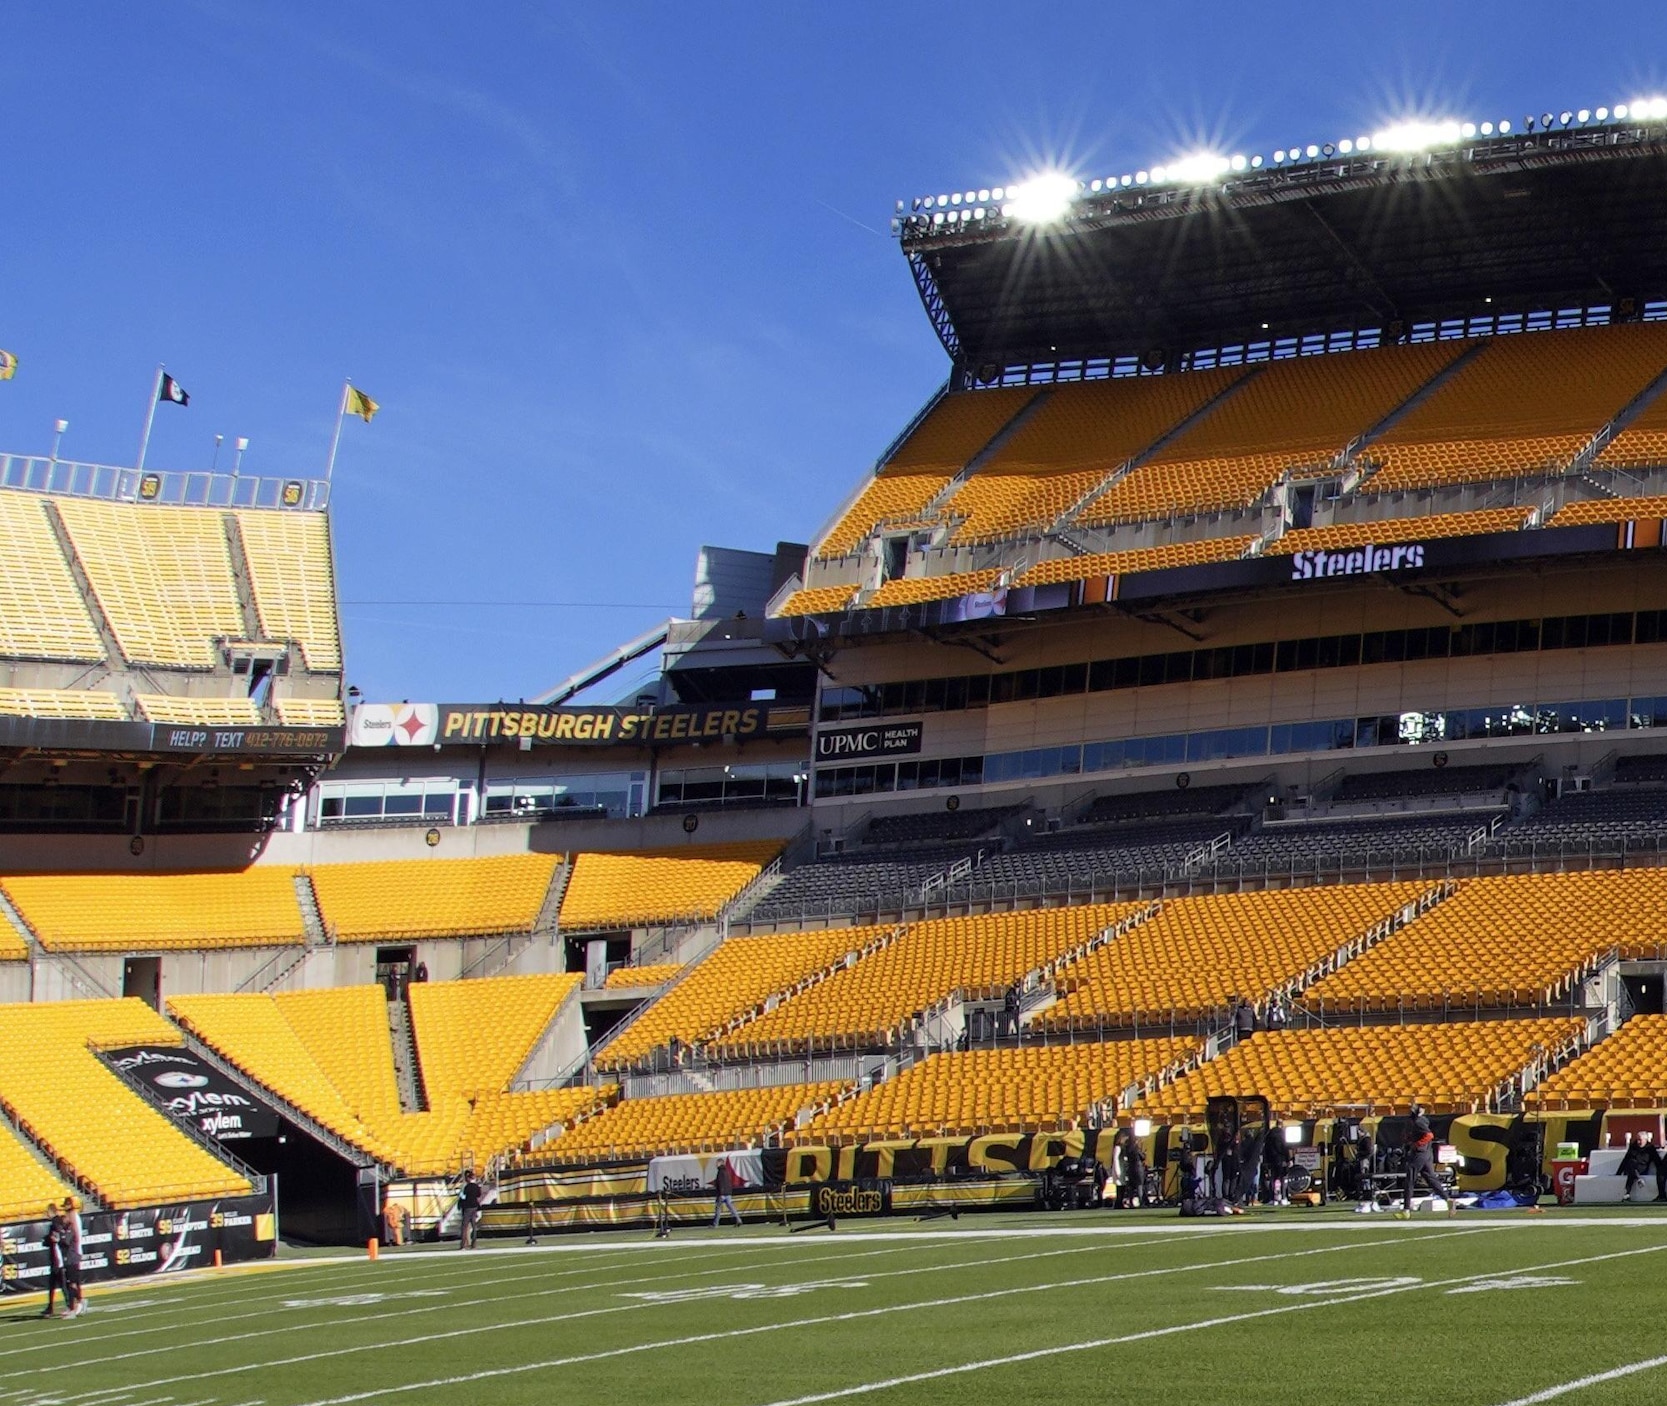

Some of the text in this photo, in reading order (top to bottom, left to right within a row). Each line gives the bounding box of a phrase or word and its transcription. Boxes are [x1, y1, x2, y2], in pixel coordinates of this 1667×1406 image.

[1291, 543, 1424, 580] Steelers
[363, 719, 392, 729] Steelers
[444, 709, 759, 740] PITTSBURGH STEELERS
[885, 728, 918, 739] HEALTH
[169, 730, 205, 746] HELP?
[215, 732, 244, 747] TEXT
[820, 732, 878, 754] UPMC
[884, 739, 907, 748] PLAN
[202, 1112, 242, 1135] xylem
[663, 1175, 700, 1191] Steelers
[819, 1186, 882, 1214] Steelers
